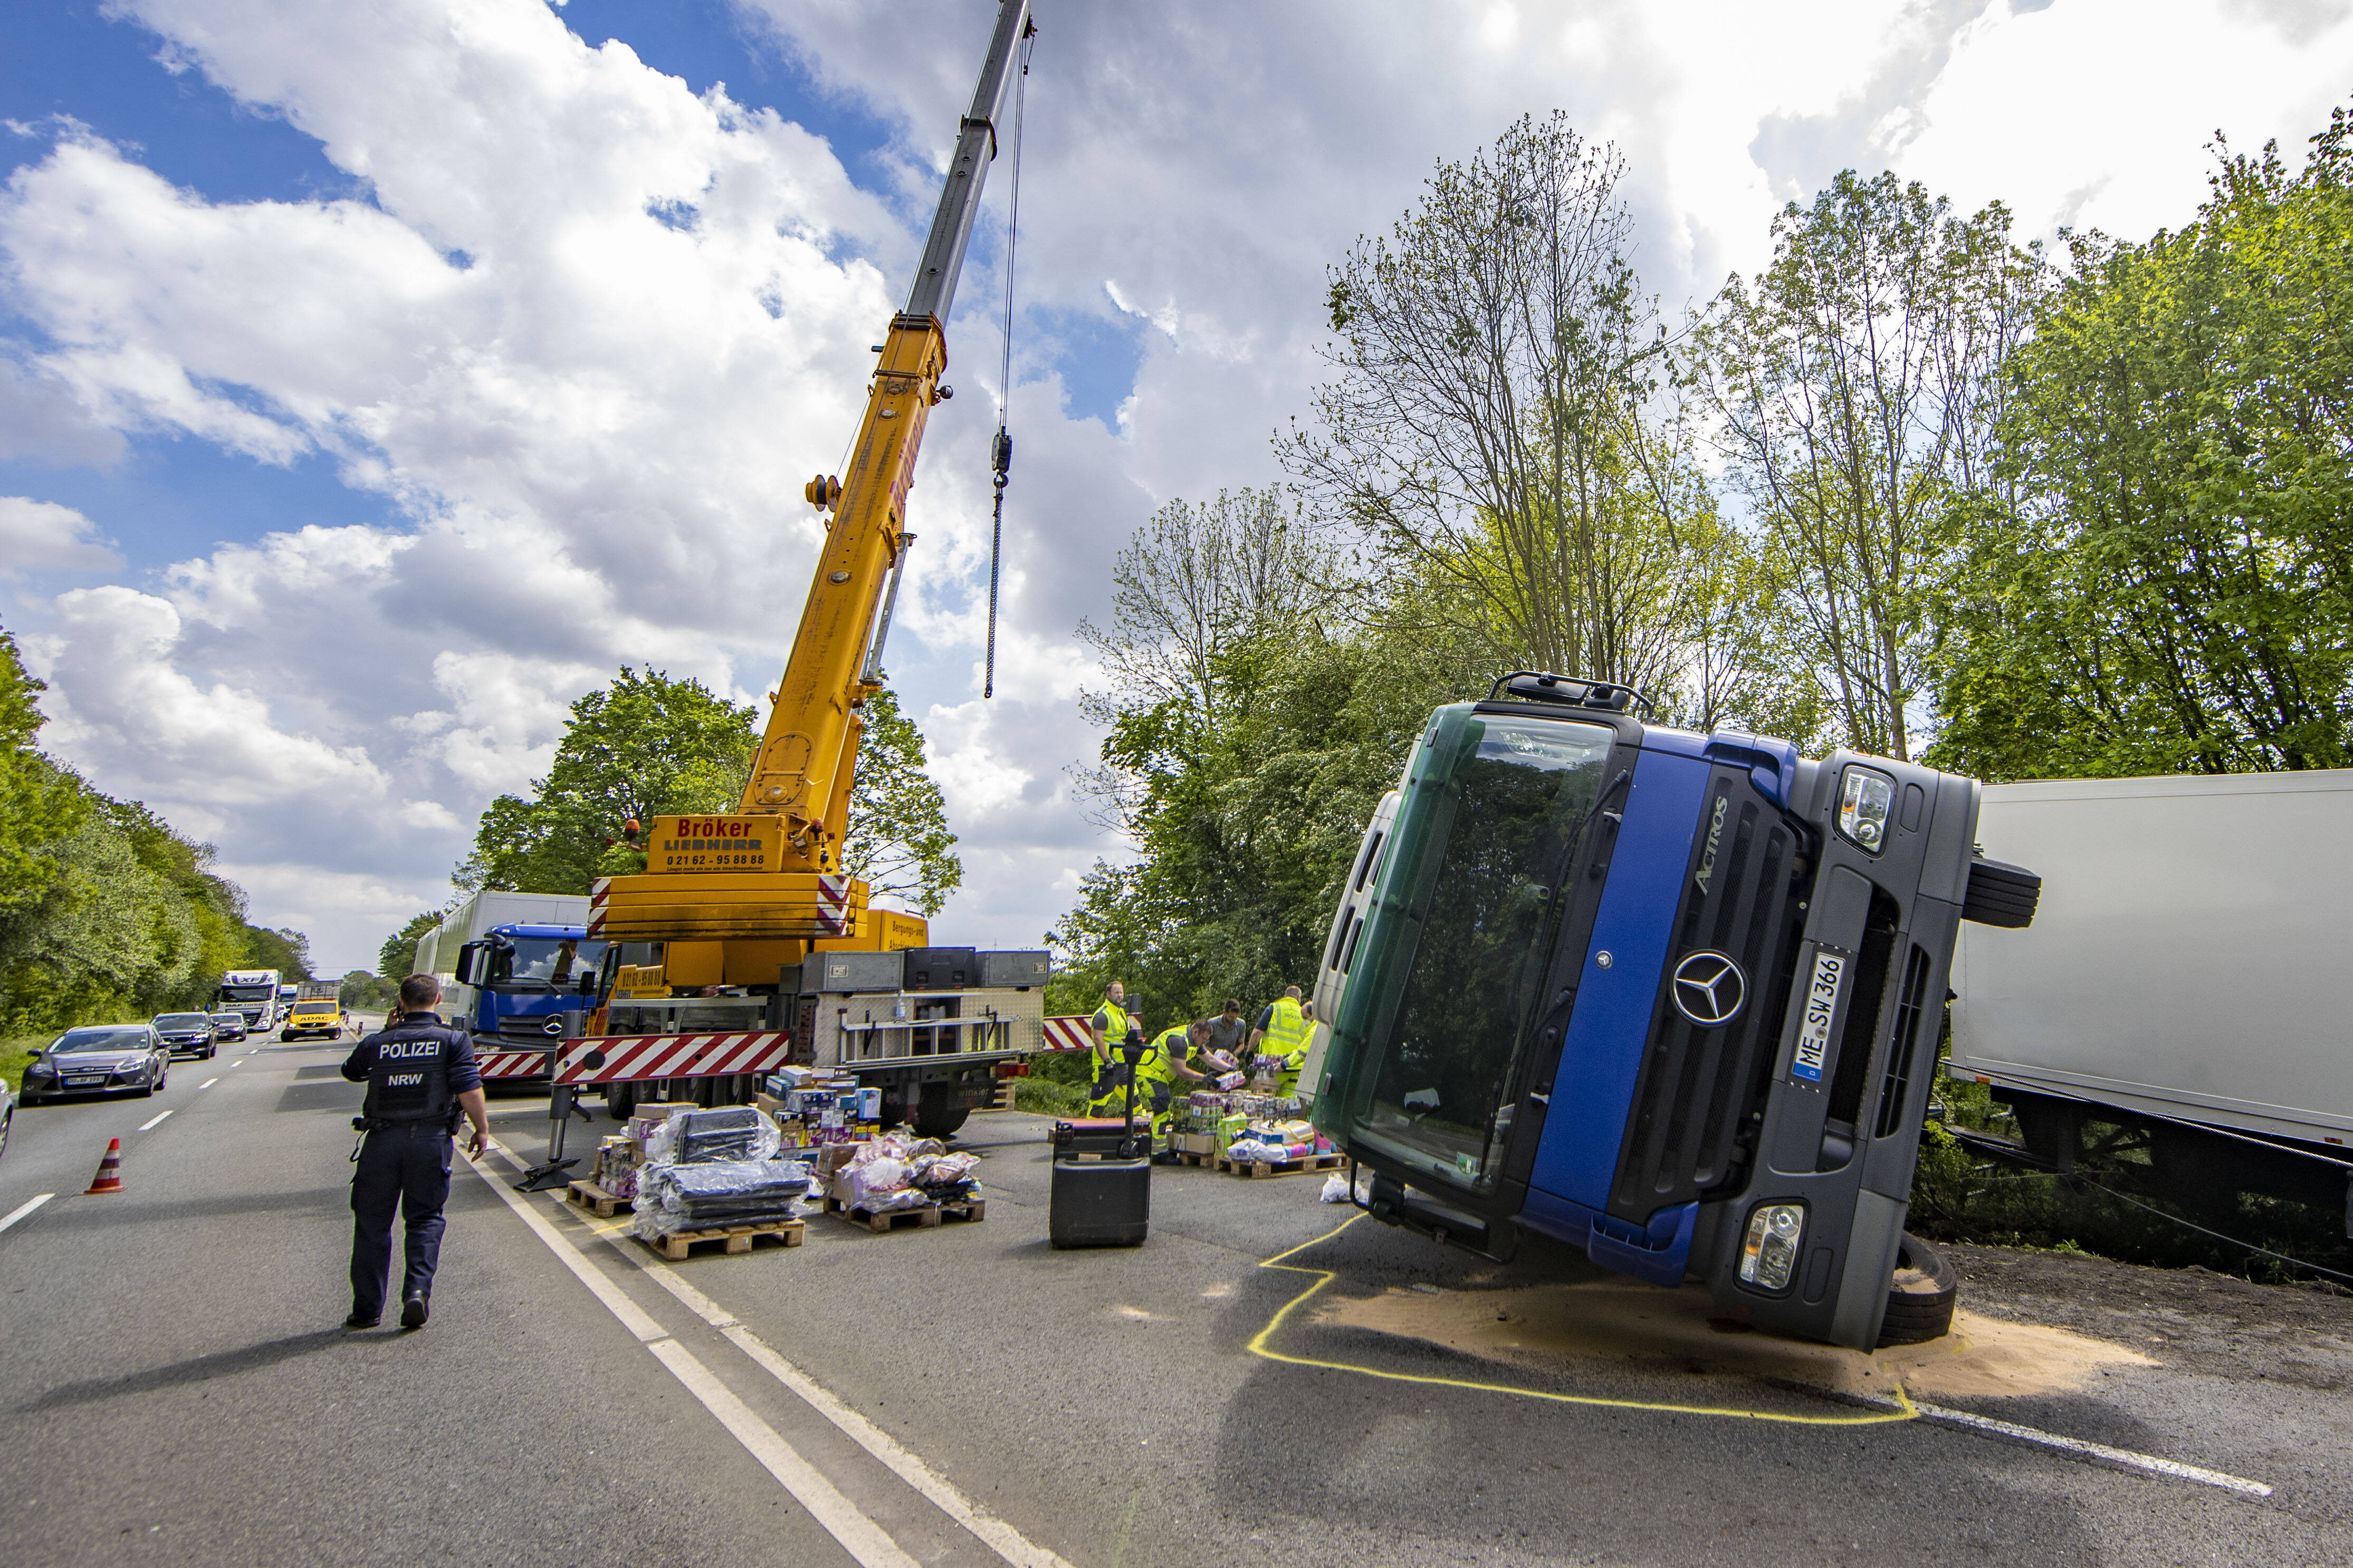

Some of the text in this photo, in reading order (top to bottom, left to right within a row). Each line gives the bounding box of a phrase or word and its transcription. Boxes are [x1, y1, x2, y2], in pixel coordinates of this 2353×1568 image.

[889, 409, 923, 518] Bröker
[677, 819, 752, 837] Bröker
[664, 839, 762, 850] LIEBHERR
[667, 855, 673, 865] 0
[676, 855, 688, 865] 21
[692, 855, 705, 864] 62
[716, 855, 730, 864] 95
[733, 855, 747, 864] 88
[751, 855, 764, 864] 88
[1799, 960, 1840, 1066] ME SW 366
[379, 1041, 440, 1059] POLIZEI
[388, 1073, 423, 1086] NRW
[958, 1088, 990, 1096] winkler
